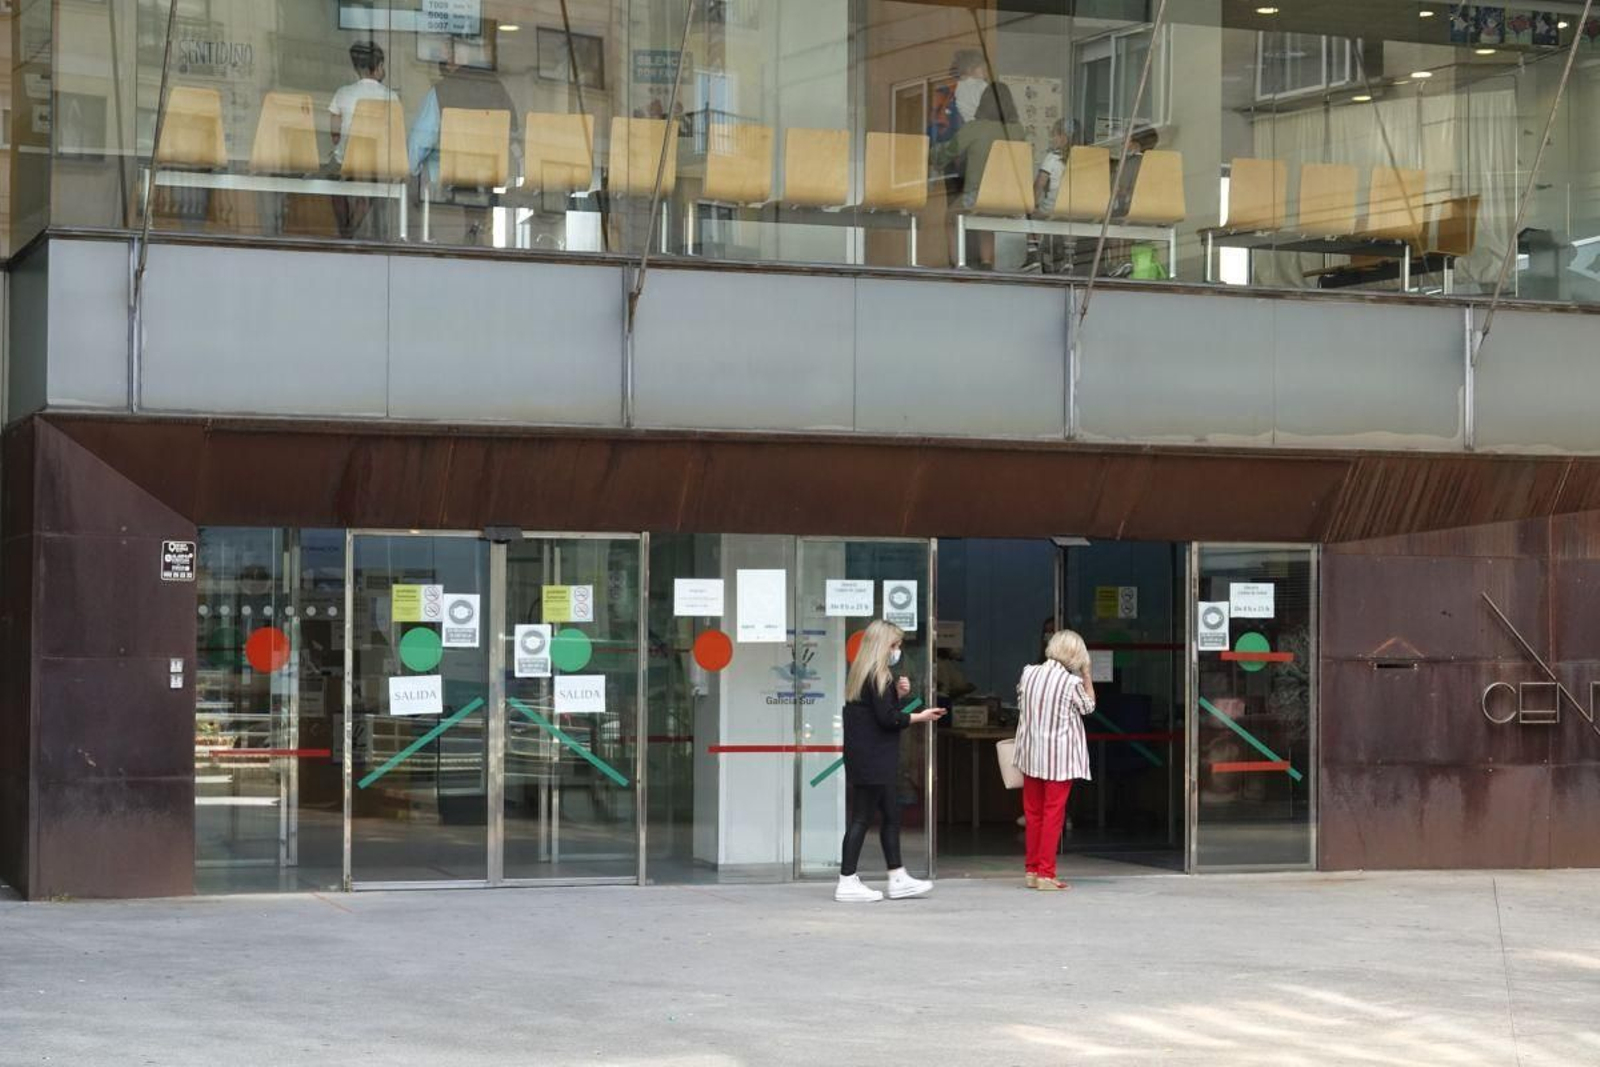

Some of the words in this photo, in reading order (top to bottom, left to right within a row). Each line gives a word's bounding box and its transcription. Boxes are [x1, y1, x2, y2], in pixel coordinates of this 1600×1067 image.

[394, 690, 437, 701] SALIDA
[559, 690, 601, 700] SALIDA
[766, 696, 797, 705] Galicia
[799, 696, 816, 705] Sur
[1482, 681, 1600, 724] CEN
